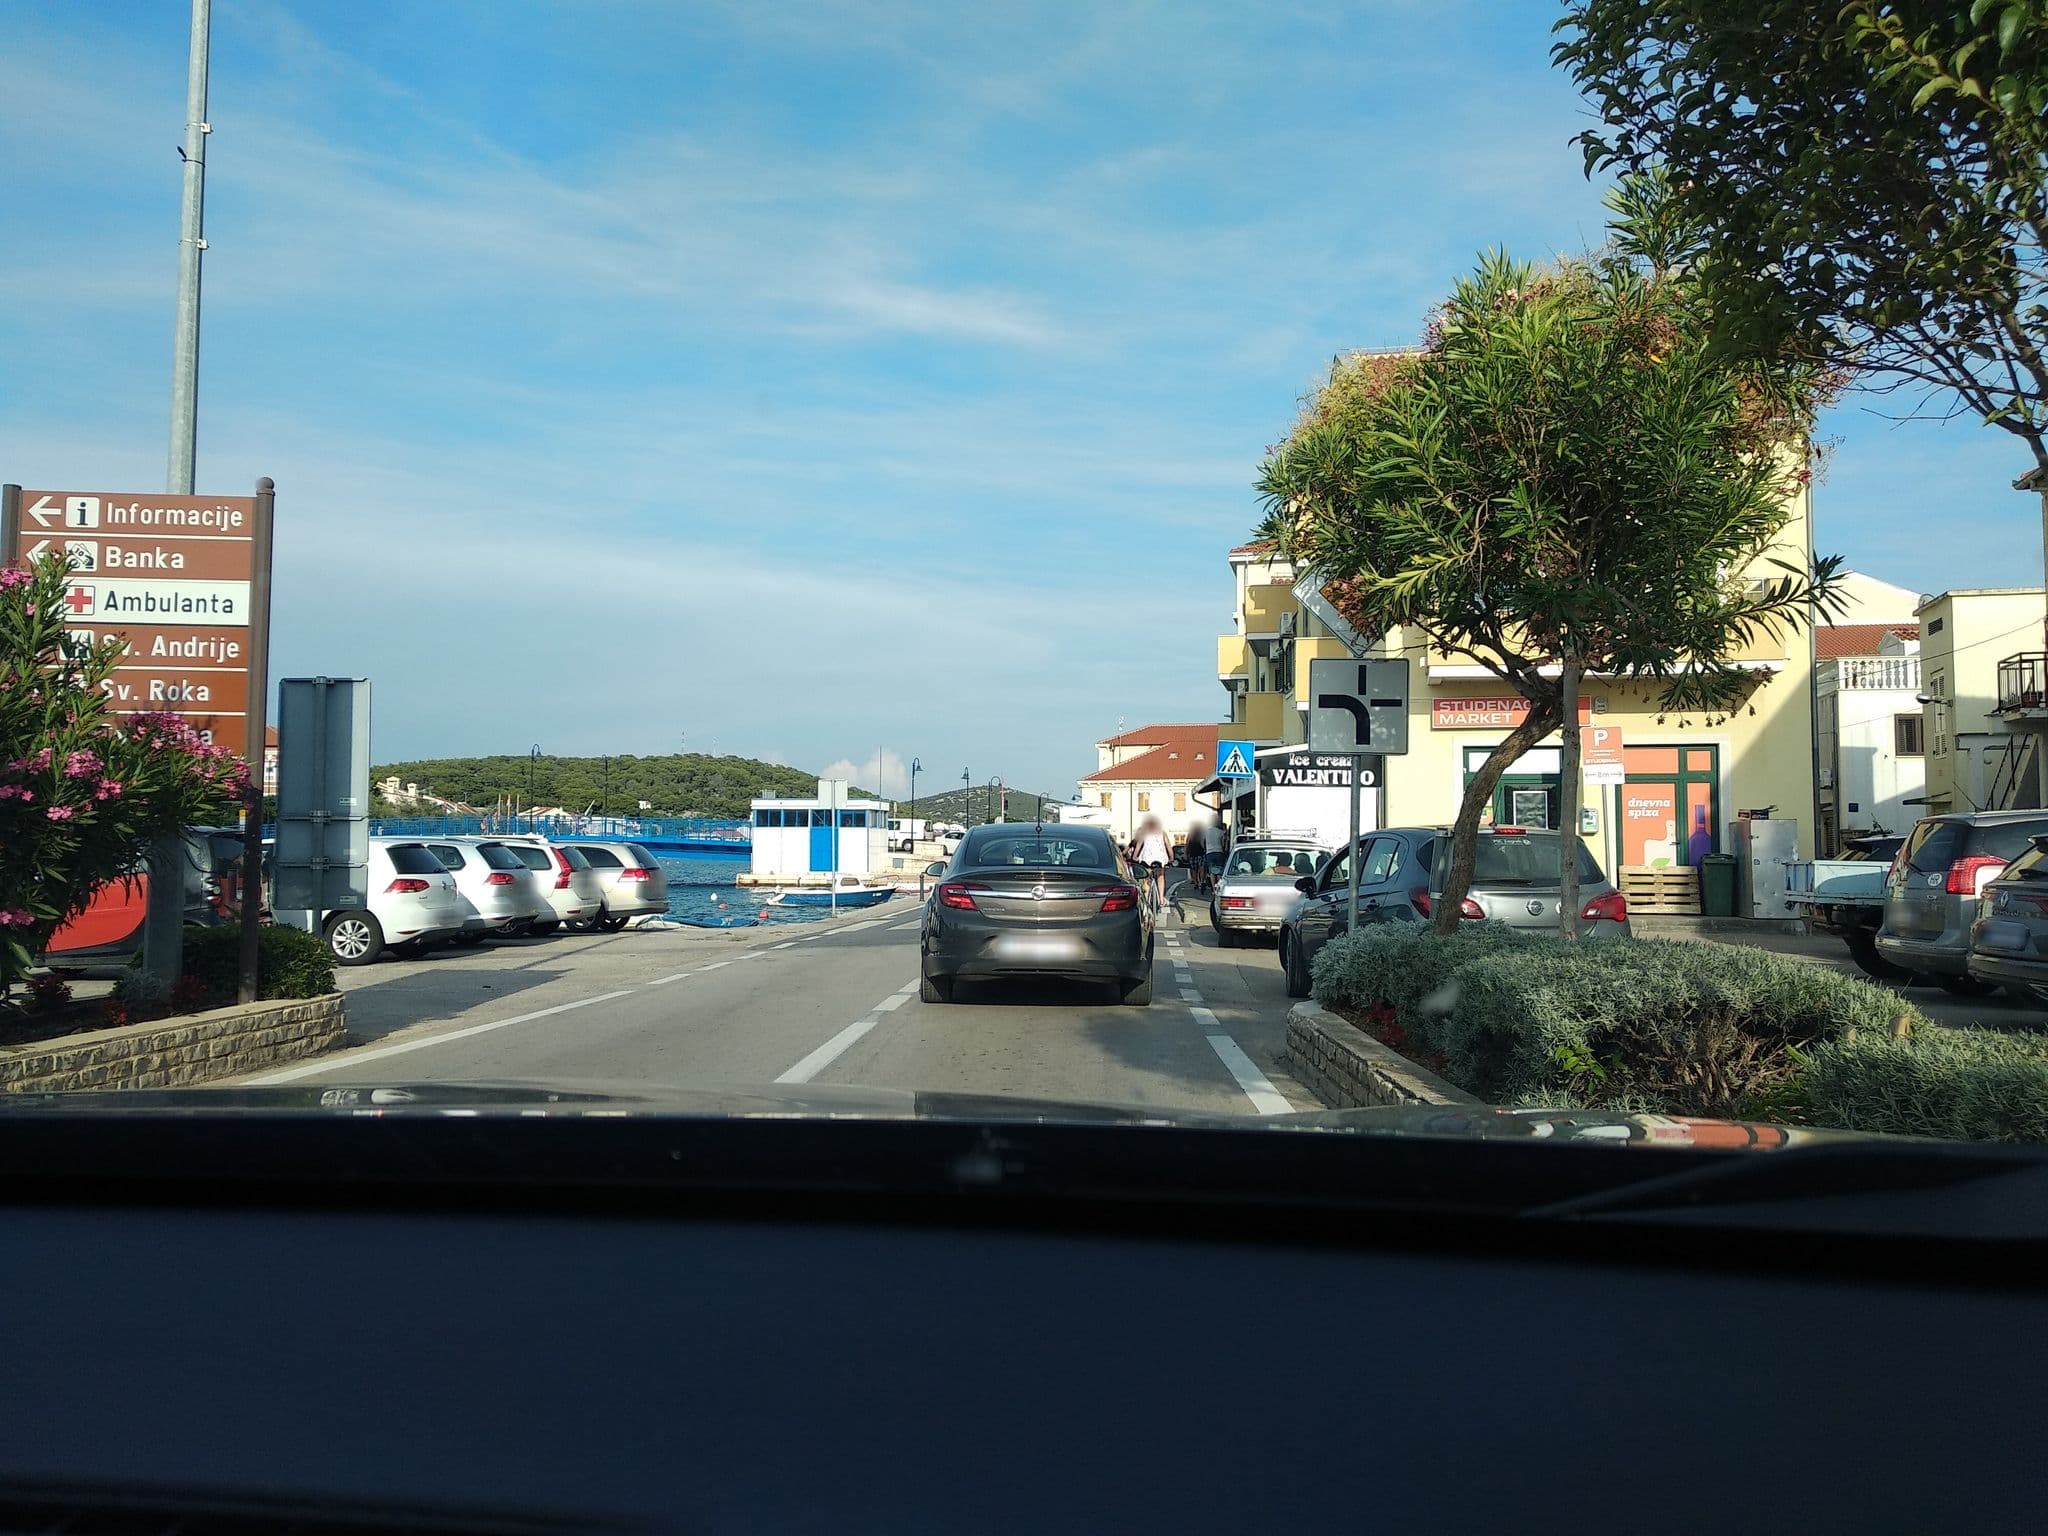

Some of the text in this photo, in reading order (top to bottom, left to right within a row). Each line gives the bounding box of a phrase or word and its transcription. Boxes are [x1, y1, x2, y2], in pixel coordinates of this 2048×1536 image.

[106, 502, 243, 531] Informacije
[105, 545, 185, 569] Banka
[104, 590, 233, 614] Ambulanta
[151, 635, 240, 664] Andrije
[100, 678, 210, 702] Sv. Roka
[1439, 712, 1513, 724] MARKET
[1593, 729, 1609, 746] P
[1288, 753, 1310, 766] Ice
[1628, 797, 1671, 807] dnevna
